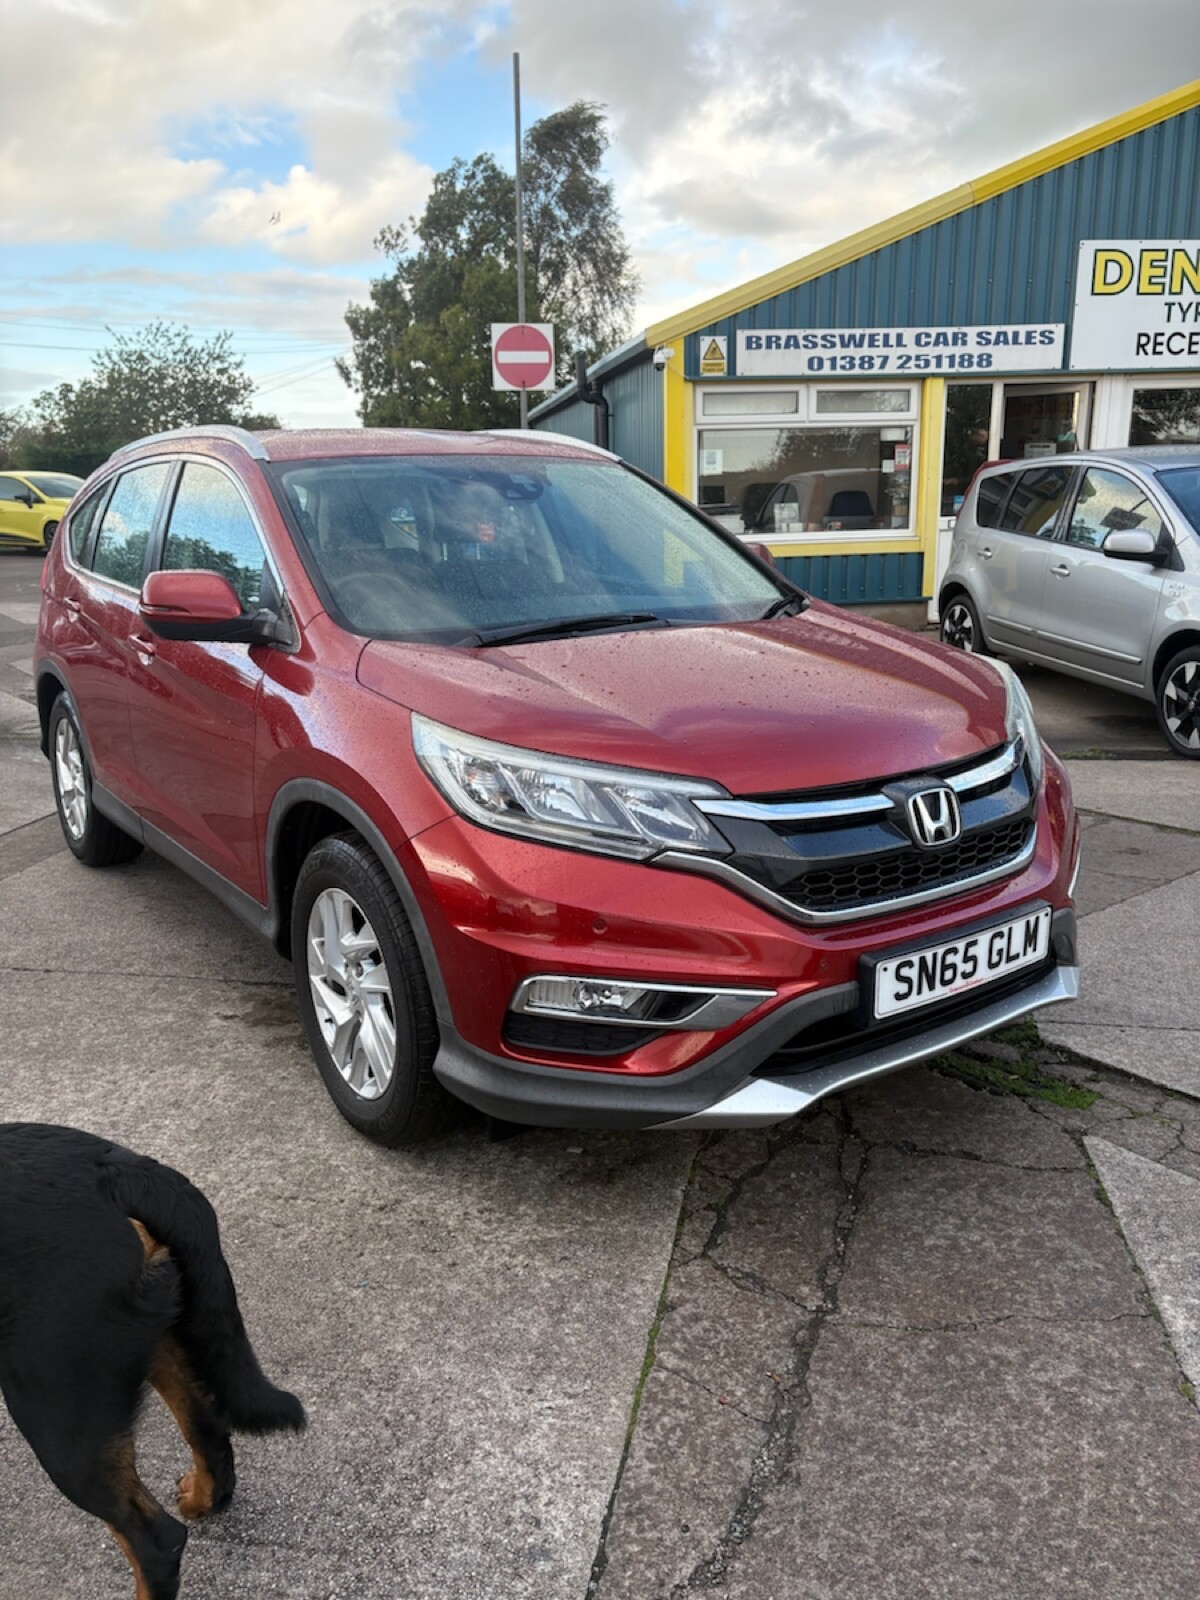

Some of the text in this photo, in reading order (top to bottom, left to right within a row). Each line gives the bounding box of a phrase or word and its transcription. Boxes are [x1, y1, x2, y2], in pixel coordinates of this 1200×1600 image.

[745, 329, 1055, 350] BRASSWELL CAR SALES
[1135, 331, 1200, 356] RECE
[807, 352, 993, 372] 01387 251188
[893, 915, 1041, 1002] SN65 GLM
